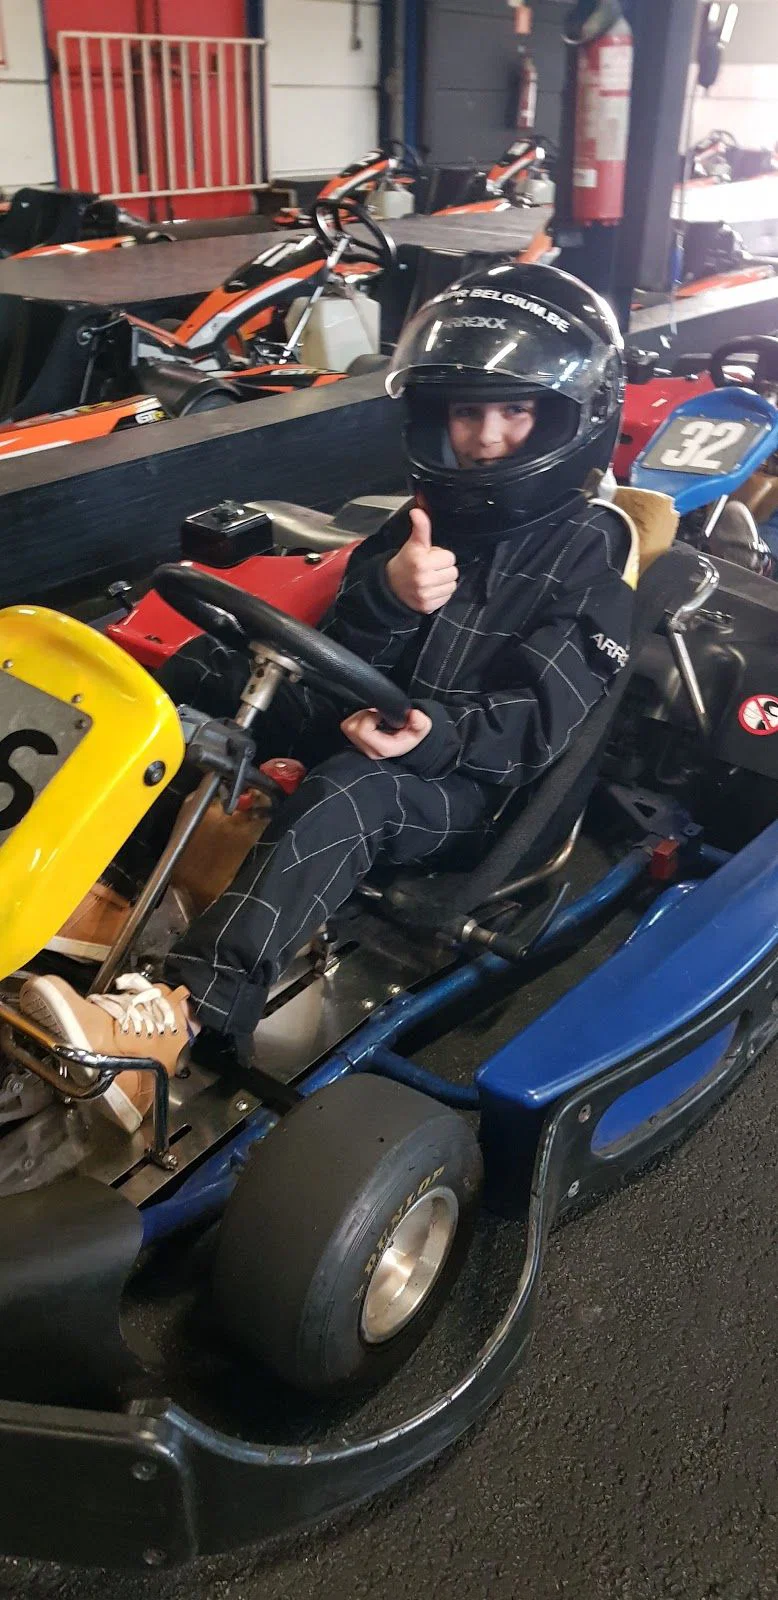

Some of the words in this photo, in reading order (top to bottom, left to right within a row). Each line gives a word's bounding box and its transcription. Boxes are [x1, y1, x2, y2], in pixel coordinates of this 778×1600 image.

[469, 288, 571, 333] BELGIUM.BE
[660, 421, 746, 469] 32
[364, 1166, 446, 1277] DUNLOP
